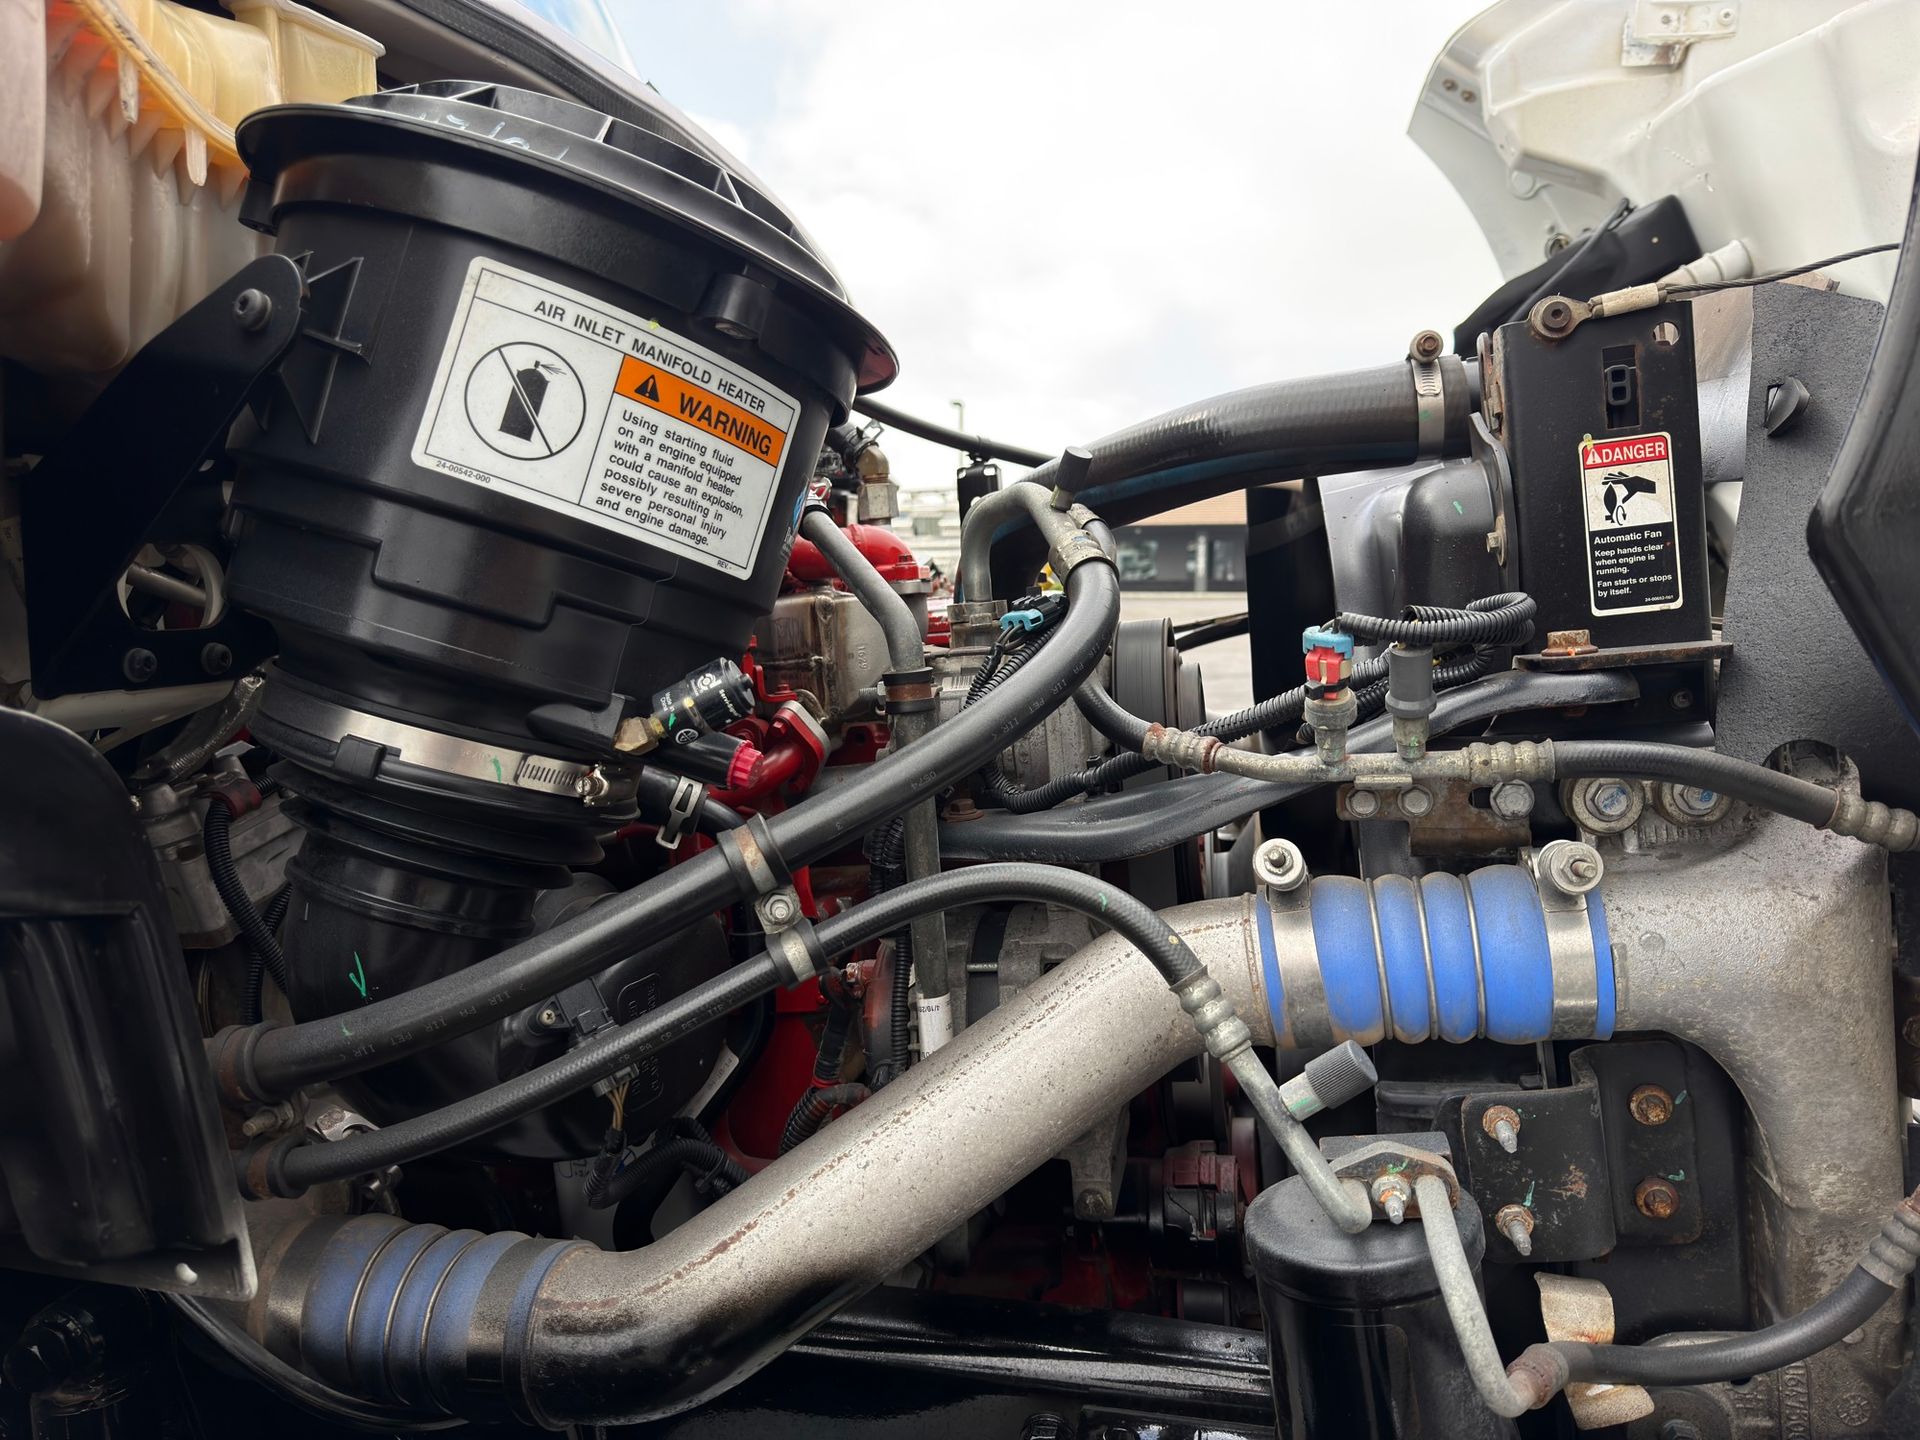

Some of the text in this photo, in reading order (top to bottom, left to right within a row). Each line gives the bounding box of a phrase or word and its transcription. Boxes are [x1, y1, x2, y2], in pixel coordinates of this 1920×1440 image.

[535, 301, 765, 413] AIR INLET MANIFOLD HEATER
[623, 410, 734, 467] Using starting fluid
[679, 392, 771, 457] WARNING
[614, 438, 735, 498] with a manifold heater
[618, 426, 742, 487] on an engine equipped
[1602, 442, 1665, 462] DANGER
[600, 483, 726, 540] severe personal injury
[604, 468, 723, 522] possibly resulting in
[609, 454, 743, 519] could cause an explosion,
[596, 496, 709, 547] and engine damage.
[1594, 530, 1662, 544] Automatic Fan
[1595, 543, 1664, 557] Keep hands clear
[1595, 557, 1617, 566] when
[1619, 556, 1645, 564] engine
[1596, 565, 1629, 575] running.
[1597, 580, 1612, 588] Fan
[1614, 578, 1637, 586] starts
[1650, 573, 1672, 583] stops
[1610, 587, 1632, 595] itself.
